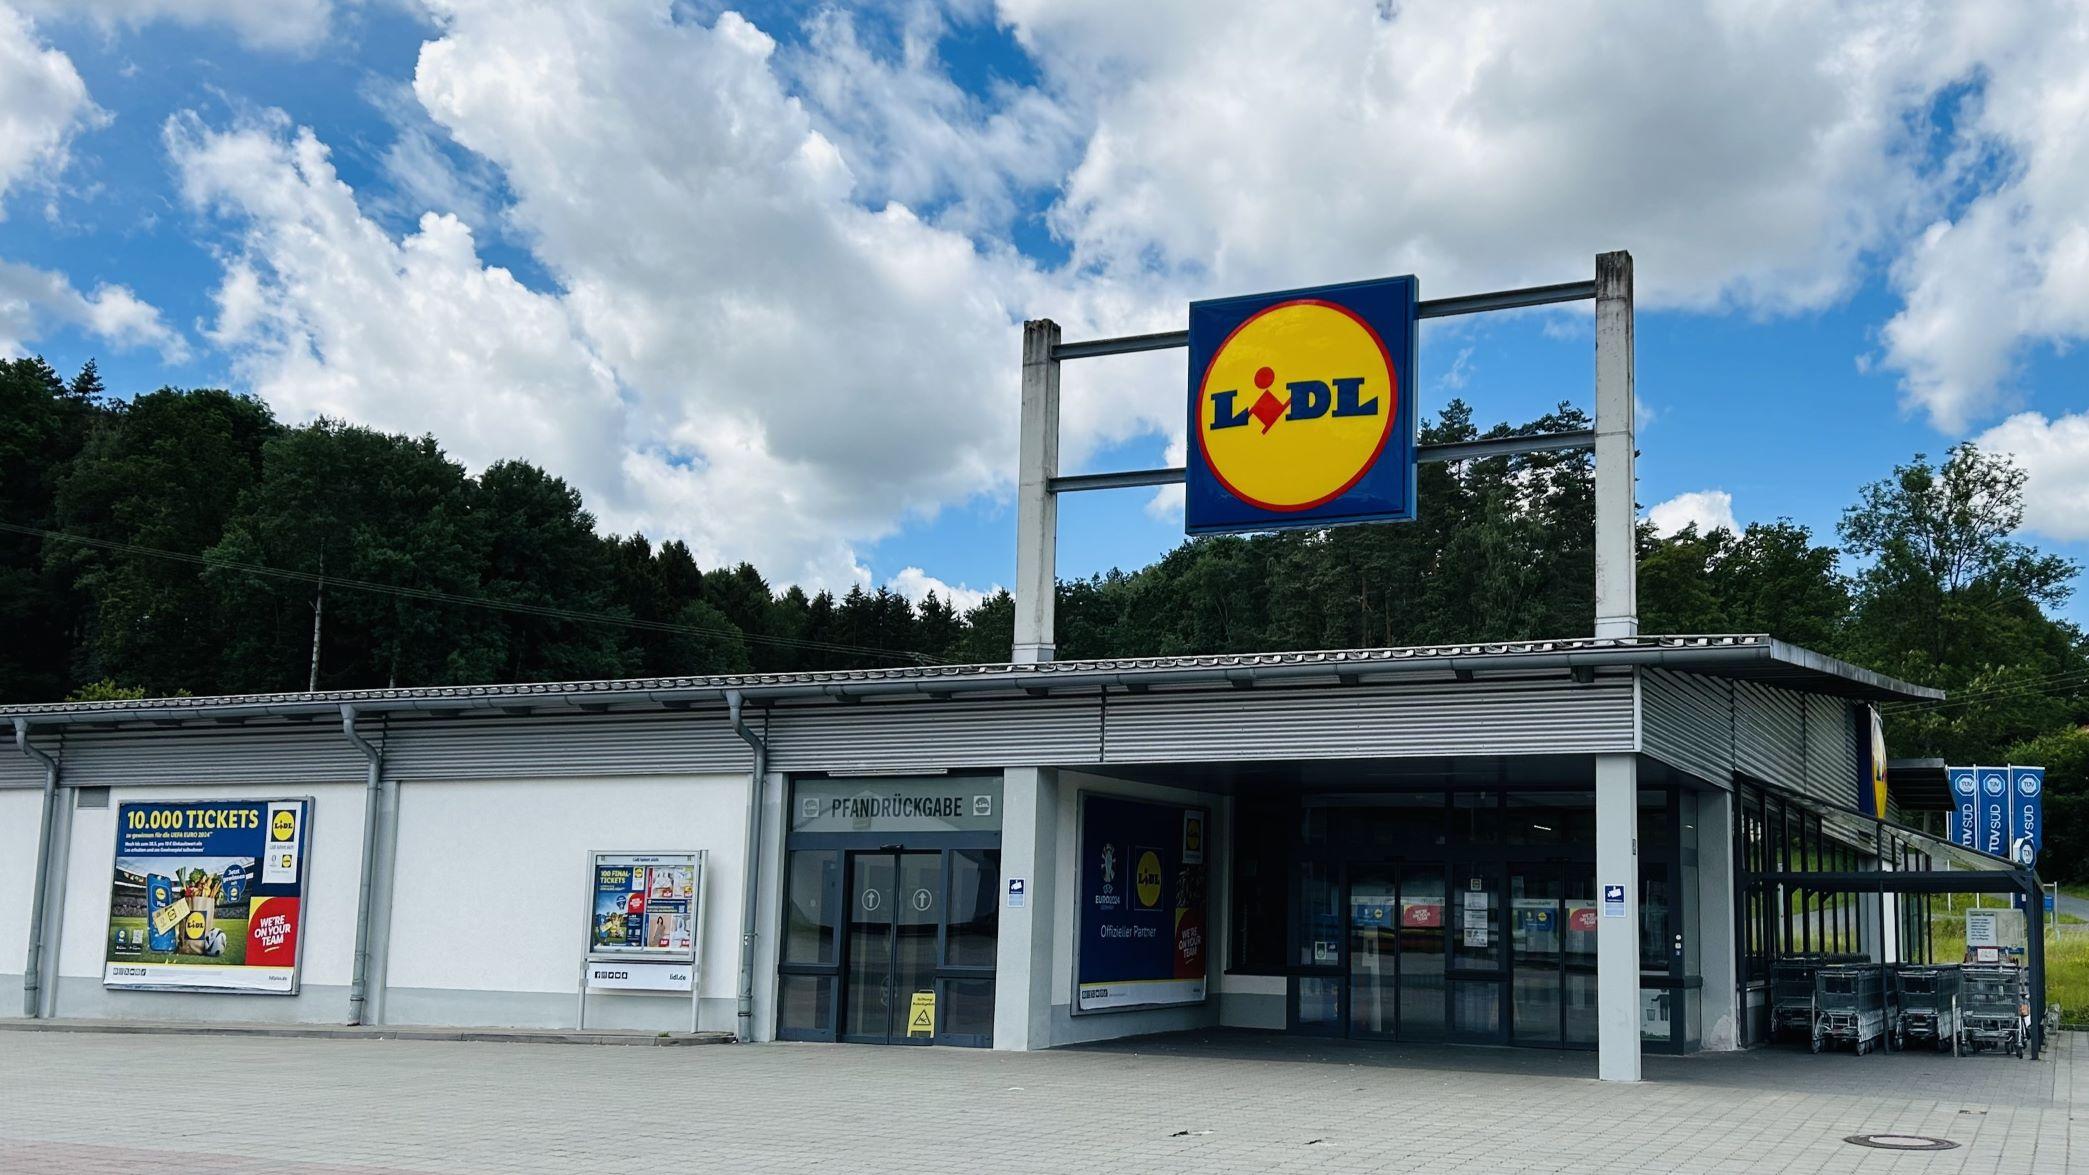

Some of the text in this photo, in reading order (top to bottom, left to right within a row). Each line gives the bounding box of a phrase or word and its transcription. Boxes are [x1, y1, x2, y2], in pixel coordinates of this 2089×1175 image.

[832, 794, 962, 818] PFANDRÜCKGABE
[128, 810, 259, 829] 10.000 TICKETS
[254, 924, 291, 938] ON YOUR
[1101, 924, 1156, 938] Offizieller Partner
[262, 934, 284, 946] TEAM
